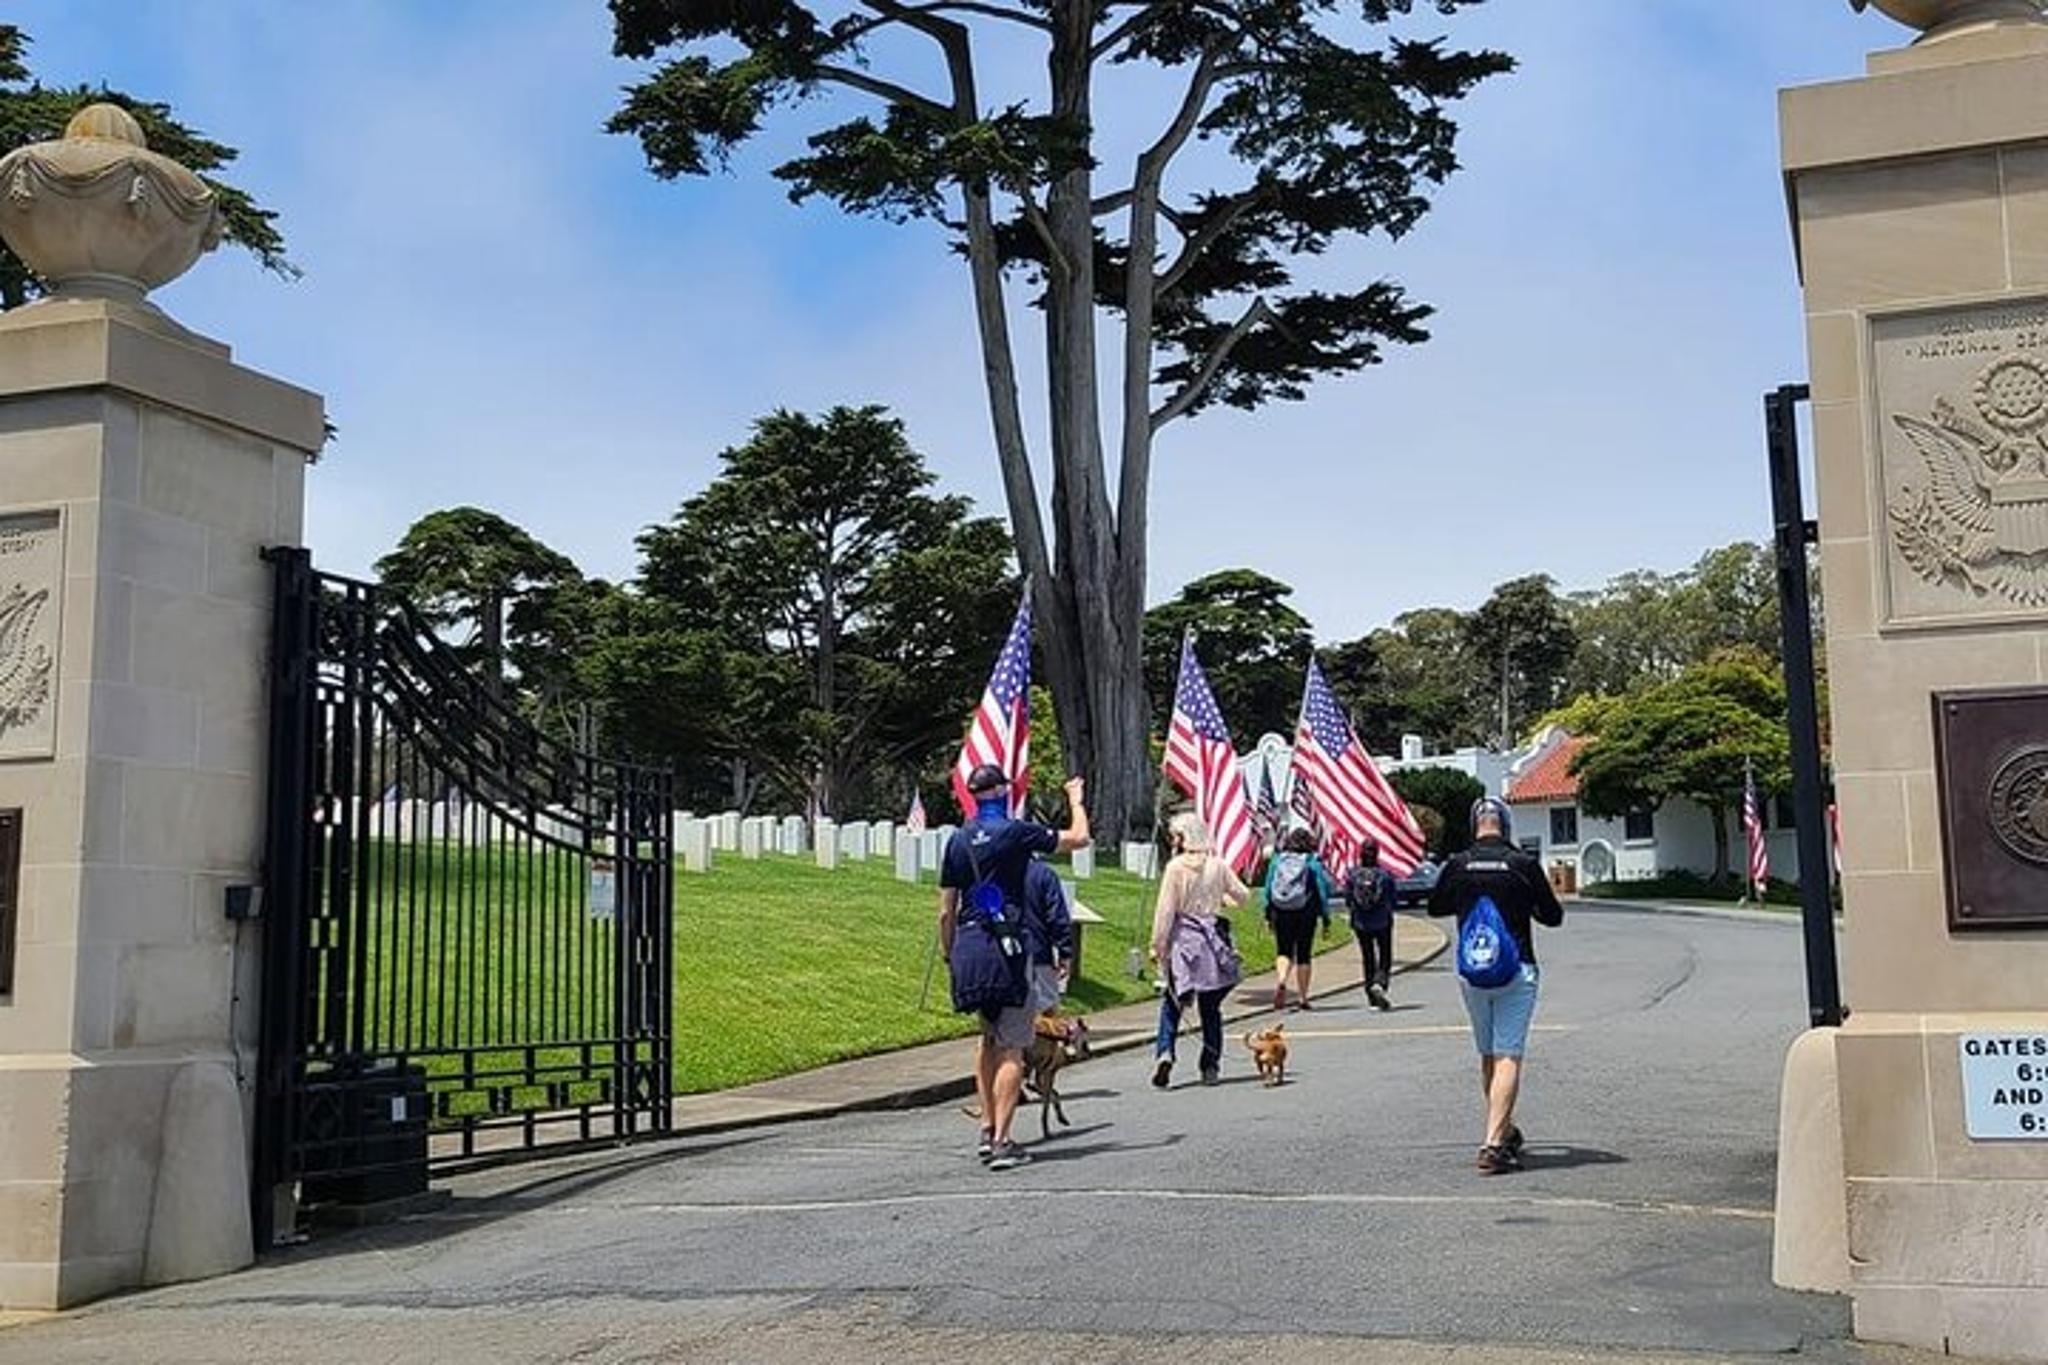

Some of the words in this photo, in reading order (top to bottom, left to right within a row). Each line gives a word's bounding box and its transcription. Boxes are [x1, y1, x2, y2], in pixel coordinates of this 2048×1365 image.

[1965, 1038, 2047, 1056] GATES
[2017, 1063, 2048, 1082] 6:
[1993, 1088, 2043, 1105] AND
